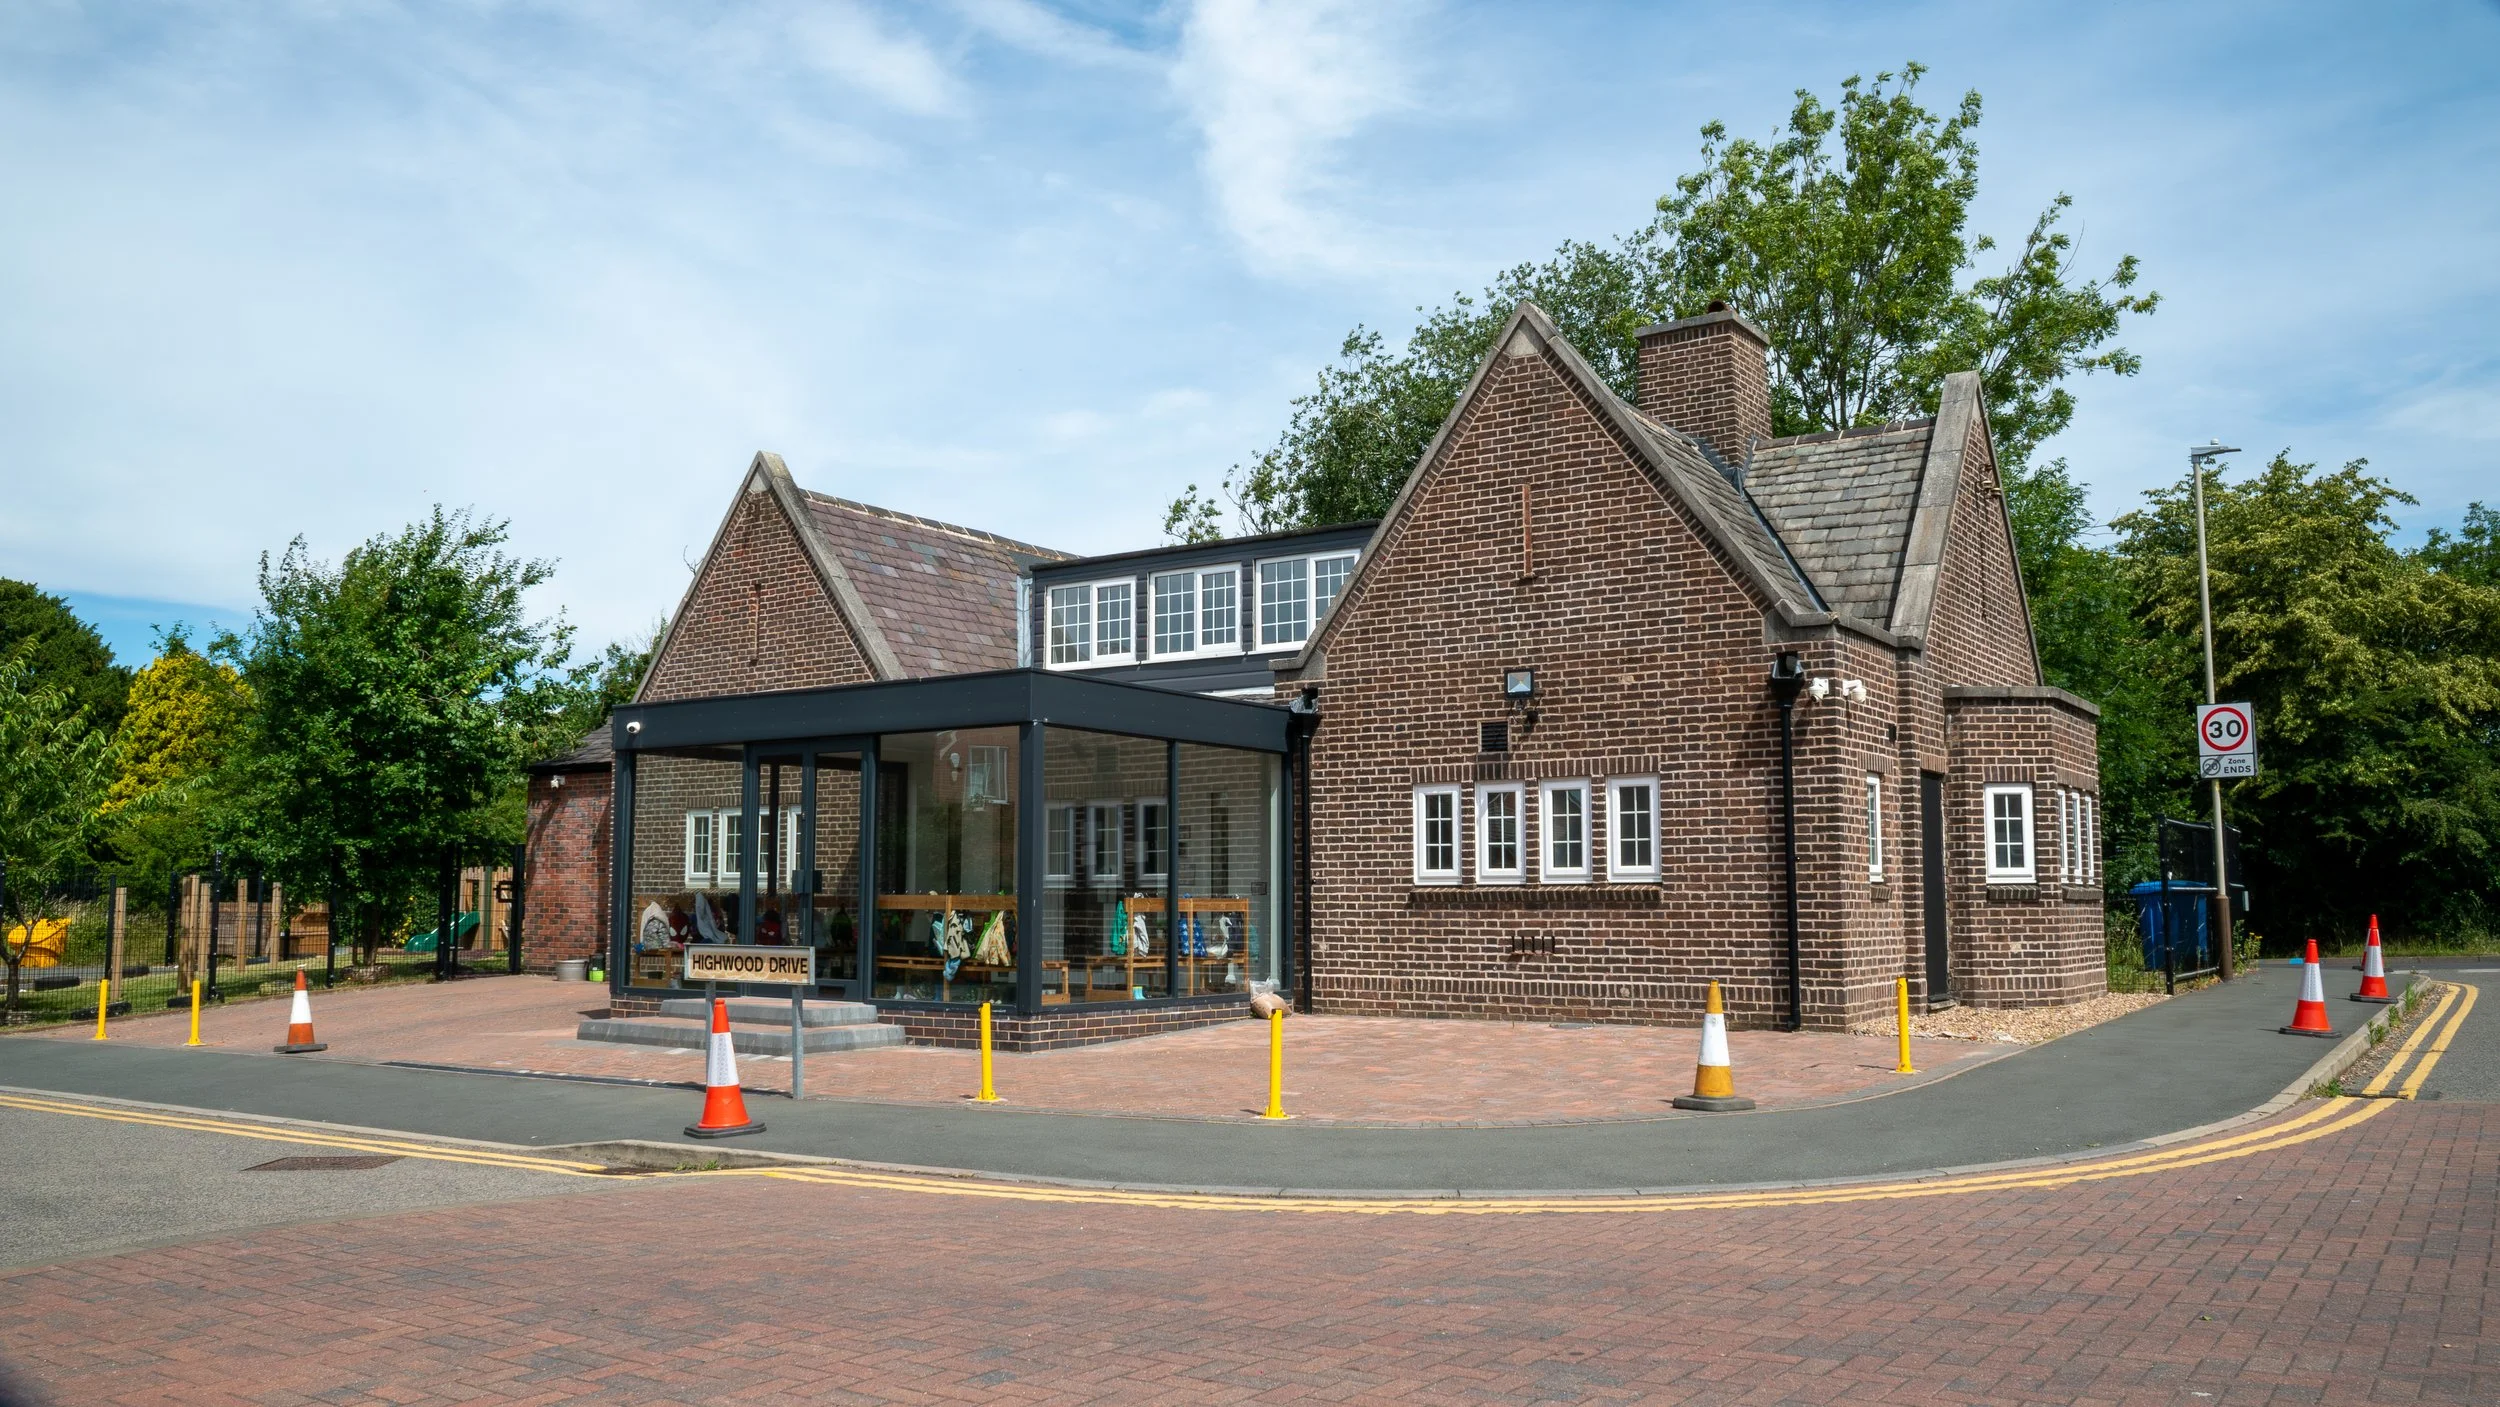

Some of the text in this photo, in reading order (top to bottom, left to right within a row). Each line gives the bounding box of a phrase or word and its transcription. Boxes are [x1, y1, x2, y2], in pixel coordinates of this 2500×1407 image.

[2208, 720, 2242, 738] 30
[2205, 763, 2218, 772] 20
[2224, 766, 2251, 774] ENDS
[692, 954, 808, 974] HIGHWOOD DRIVE
